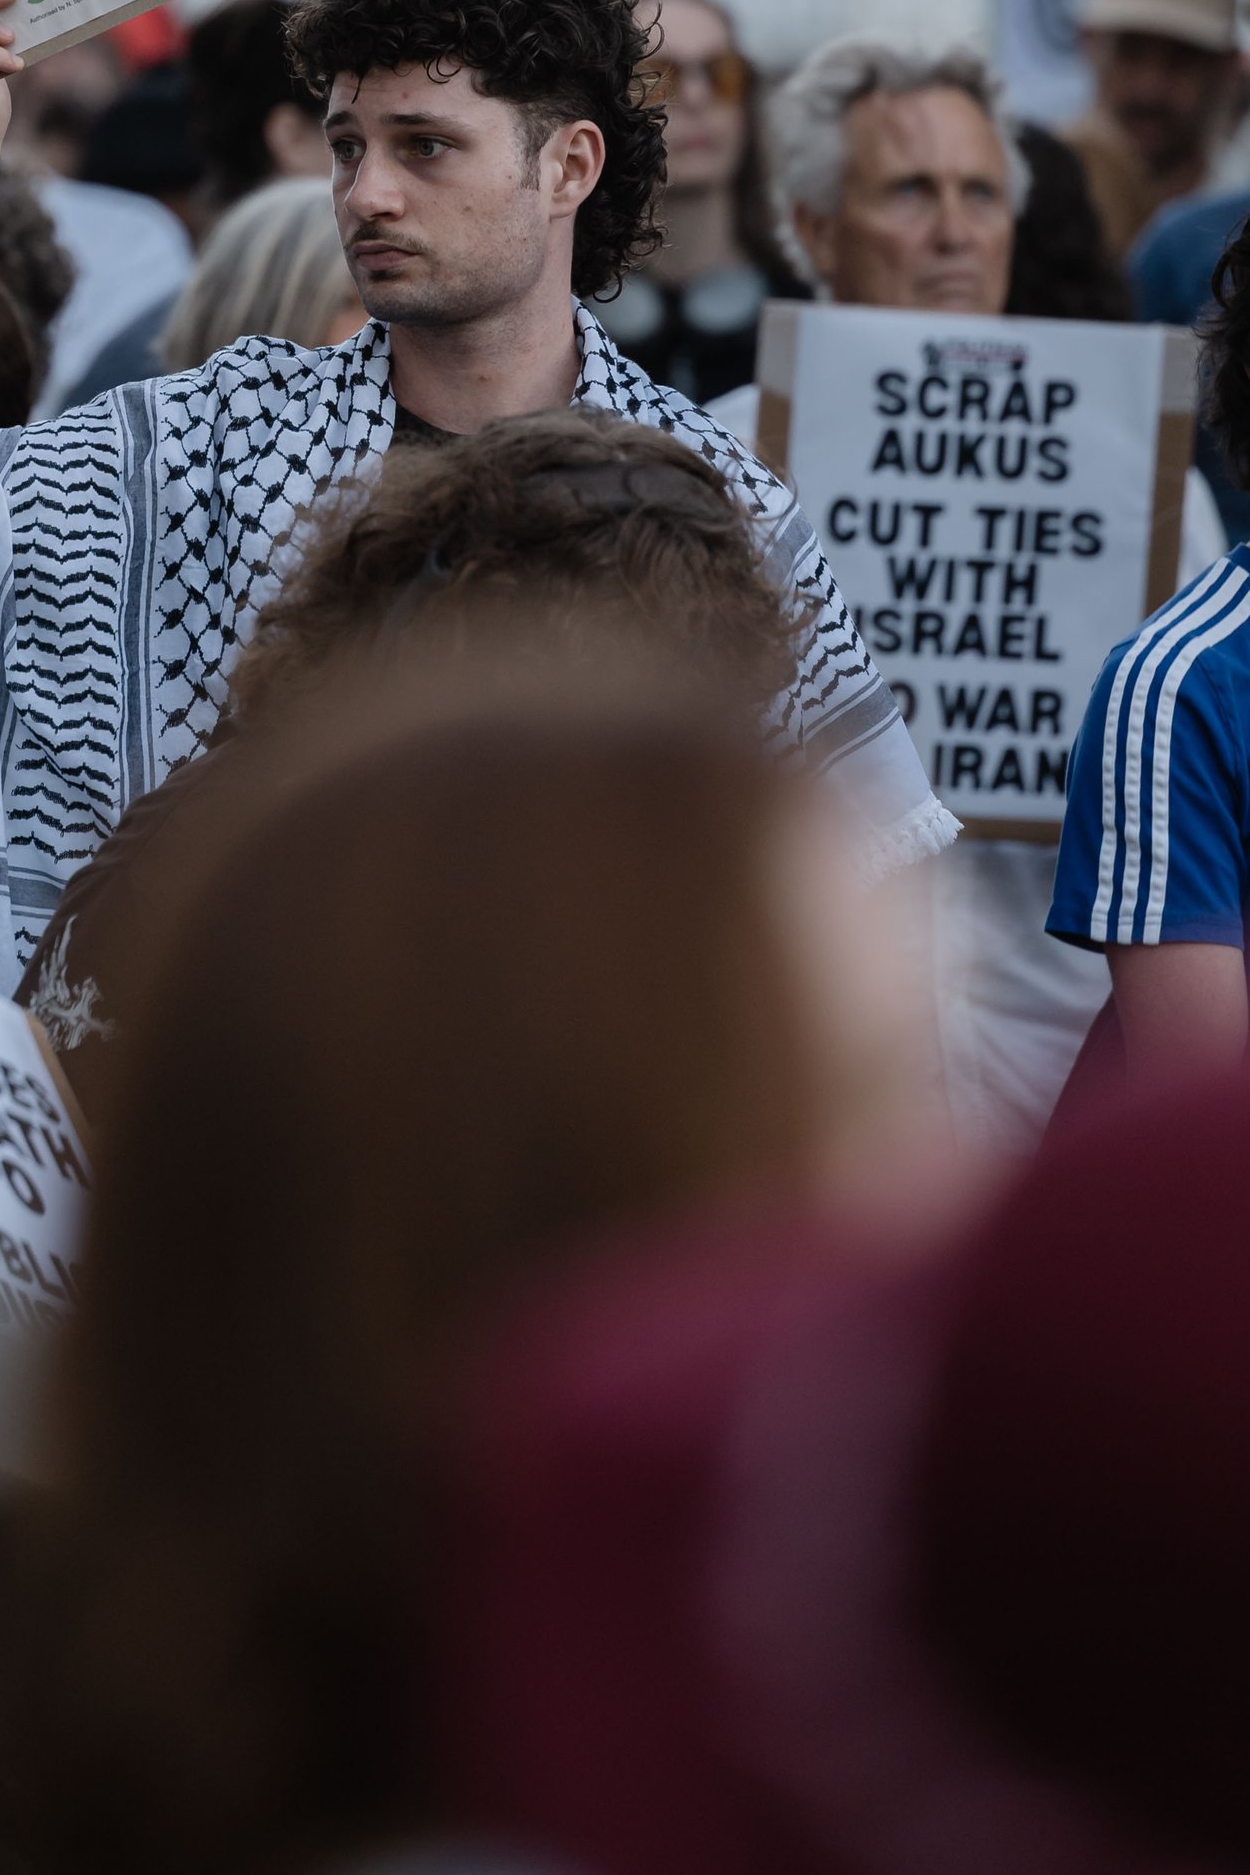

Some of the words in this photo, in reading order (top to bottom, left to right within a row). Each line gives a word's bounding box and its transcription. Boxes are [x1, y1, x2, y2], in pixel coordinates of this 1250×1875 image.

[874, 370, 1079, 425] SCRAP
[870, 429, 1071, 483] AUKUS
[827, 498, 945, 549] CUT
[975, 505, 1105, 558] TIES
[887, 555, 1041, 608] WITH
[937, 684, 1064, 736] WAR
[932, 743, 1071, 796] IRAN
